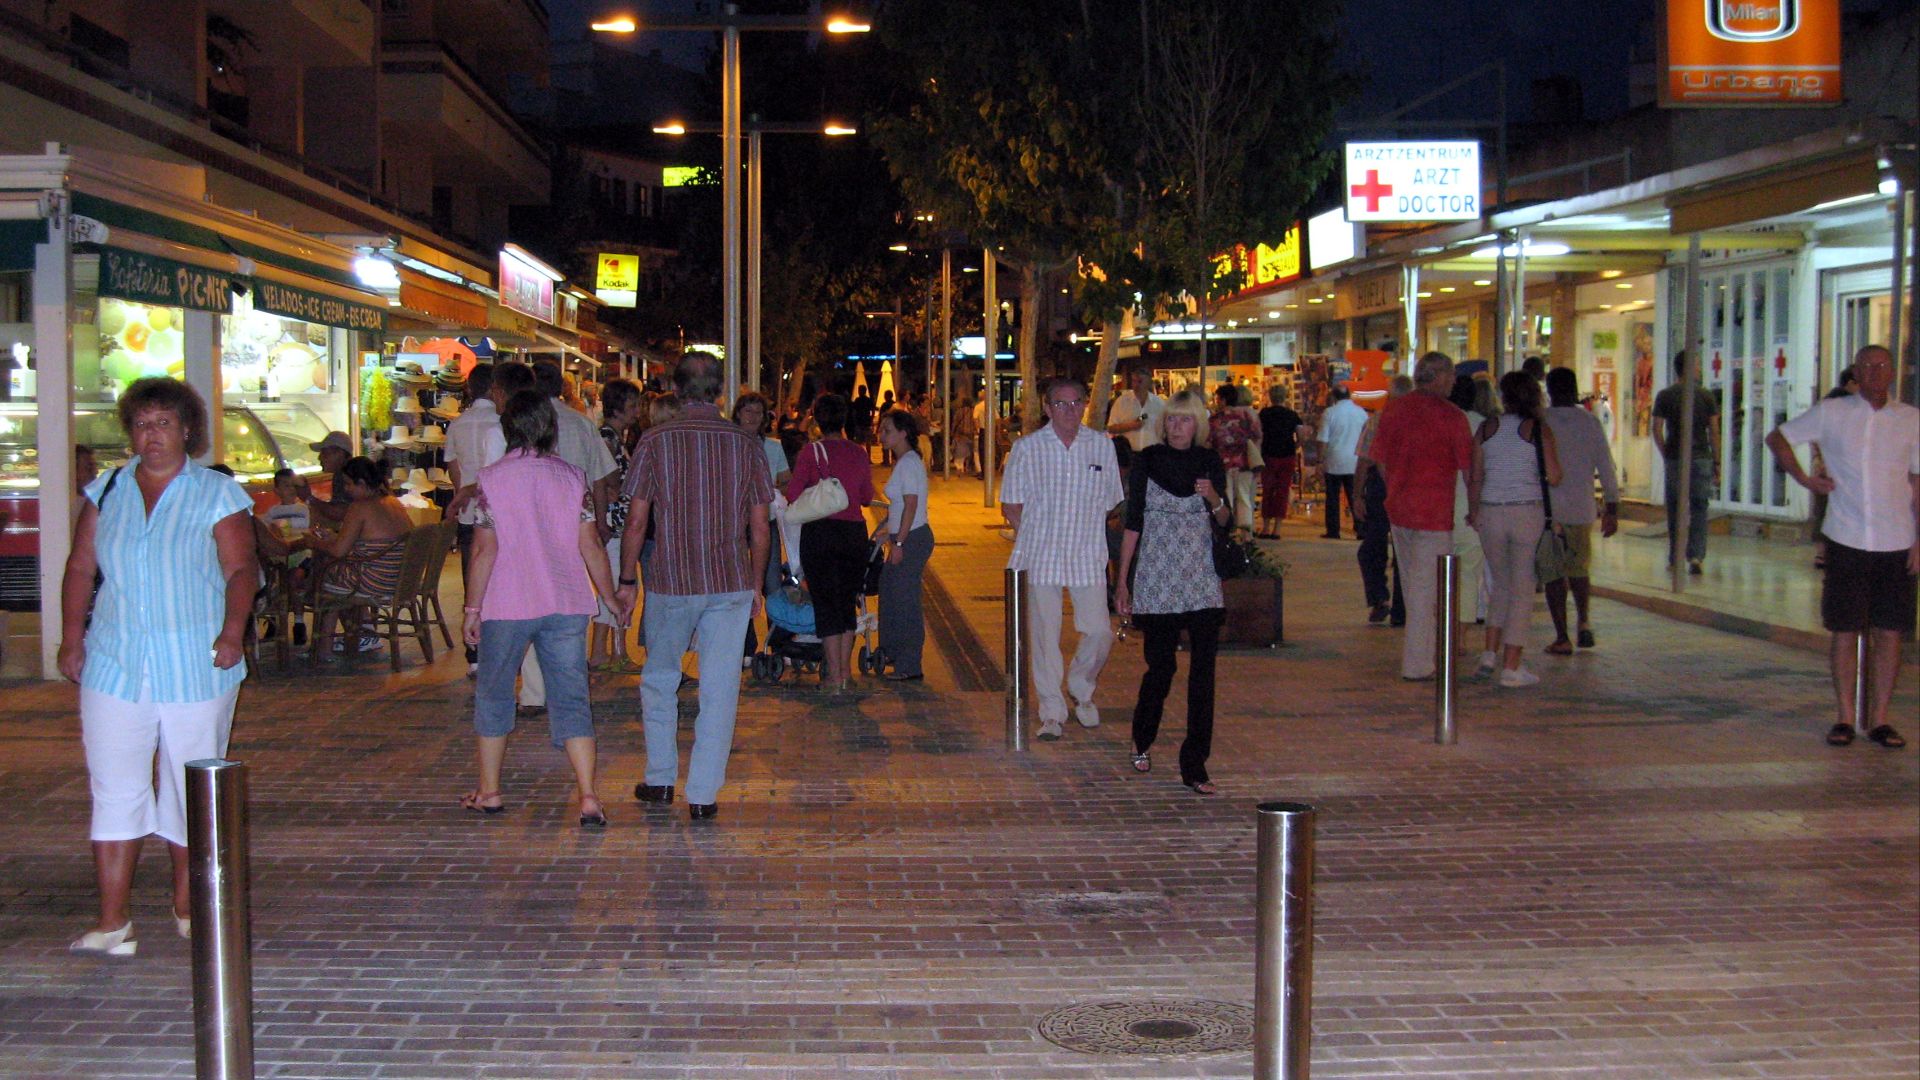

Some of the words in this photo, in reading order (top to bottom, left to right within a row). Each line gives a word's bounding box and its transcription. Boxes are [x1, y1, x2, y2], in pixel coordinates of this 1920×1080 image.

[1683, 72, 1824, 88] Urbano
[1354, 148, 1472, 161] ARZTZENTRUM
[1413, 168, 1461, 185] ARZT
[1399, 195, 1475, 213] DOCTOR
[603, 279, 630, 288] Kodak
